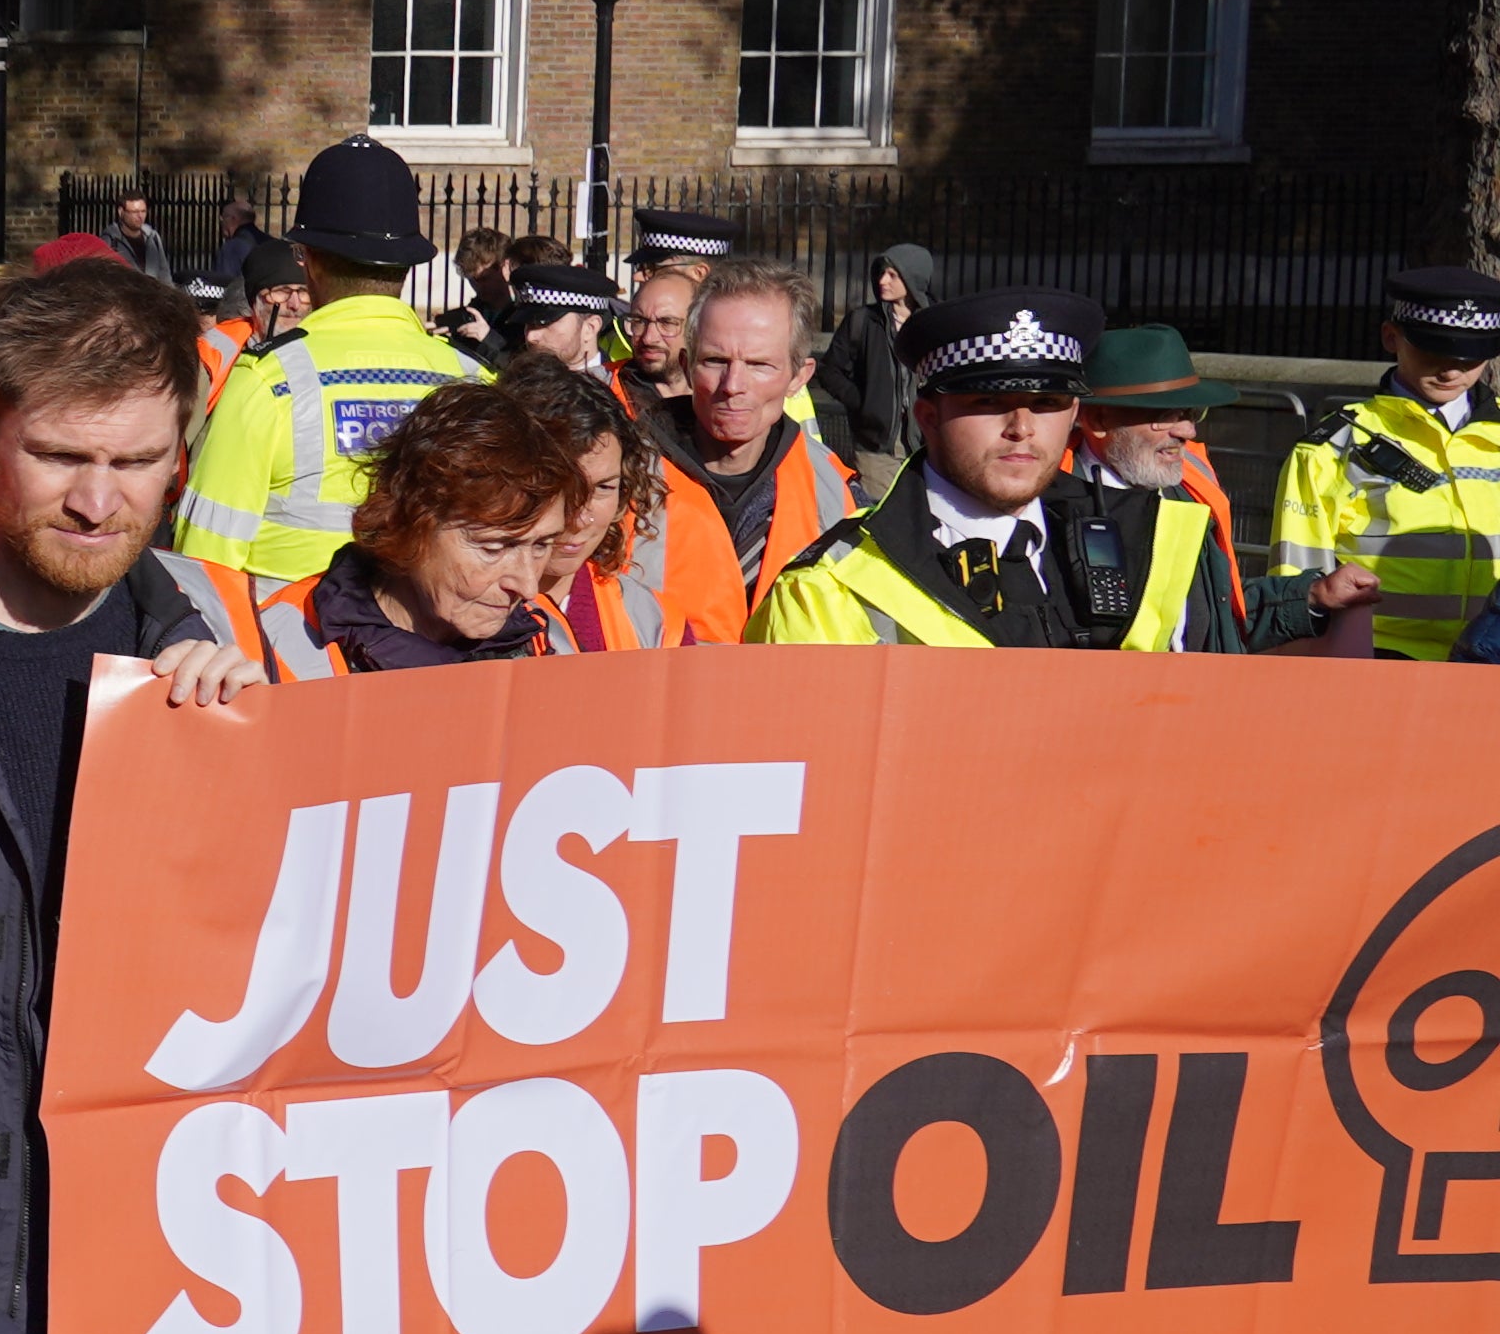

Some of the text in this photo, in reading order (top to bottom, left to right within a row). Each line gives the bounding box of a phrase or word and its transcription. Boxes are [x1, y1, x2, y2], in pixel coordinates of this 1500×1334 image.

[340, 404, 417, 418] METROP
[1282, 499, 1319, 519] POLICE
[144, 762, 805, 1091] JUST
[828, 1052, 1301, 1315] OIL
